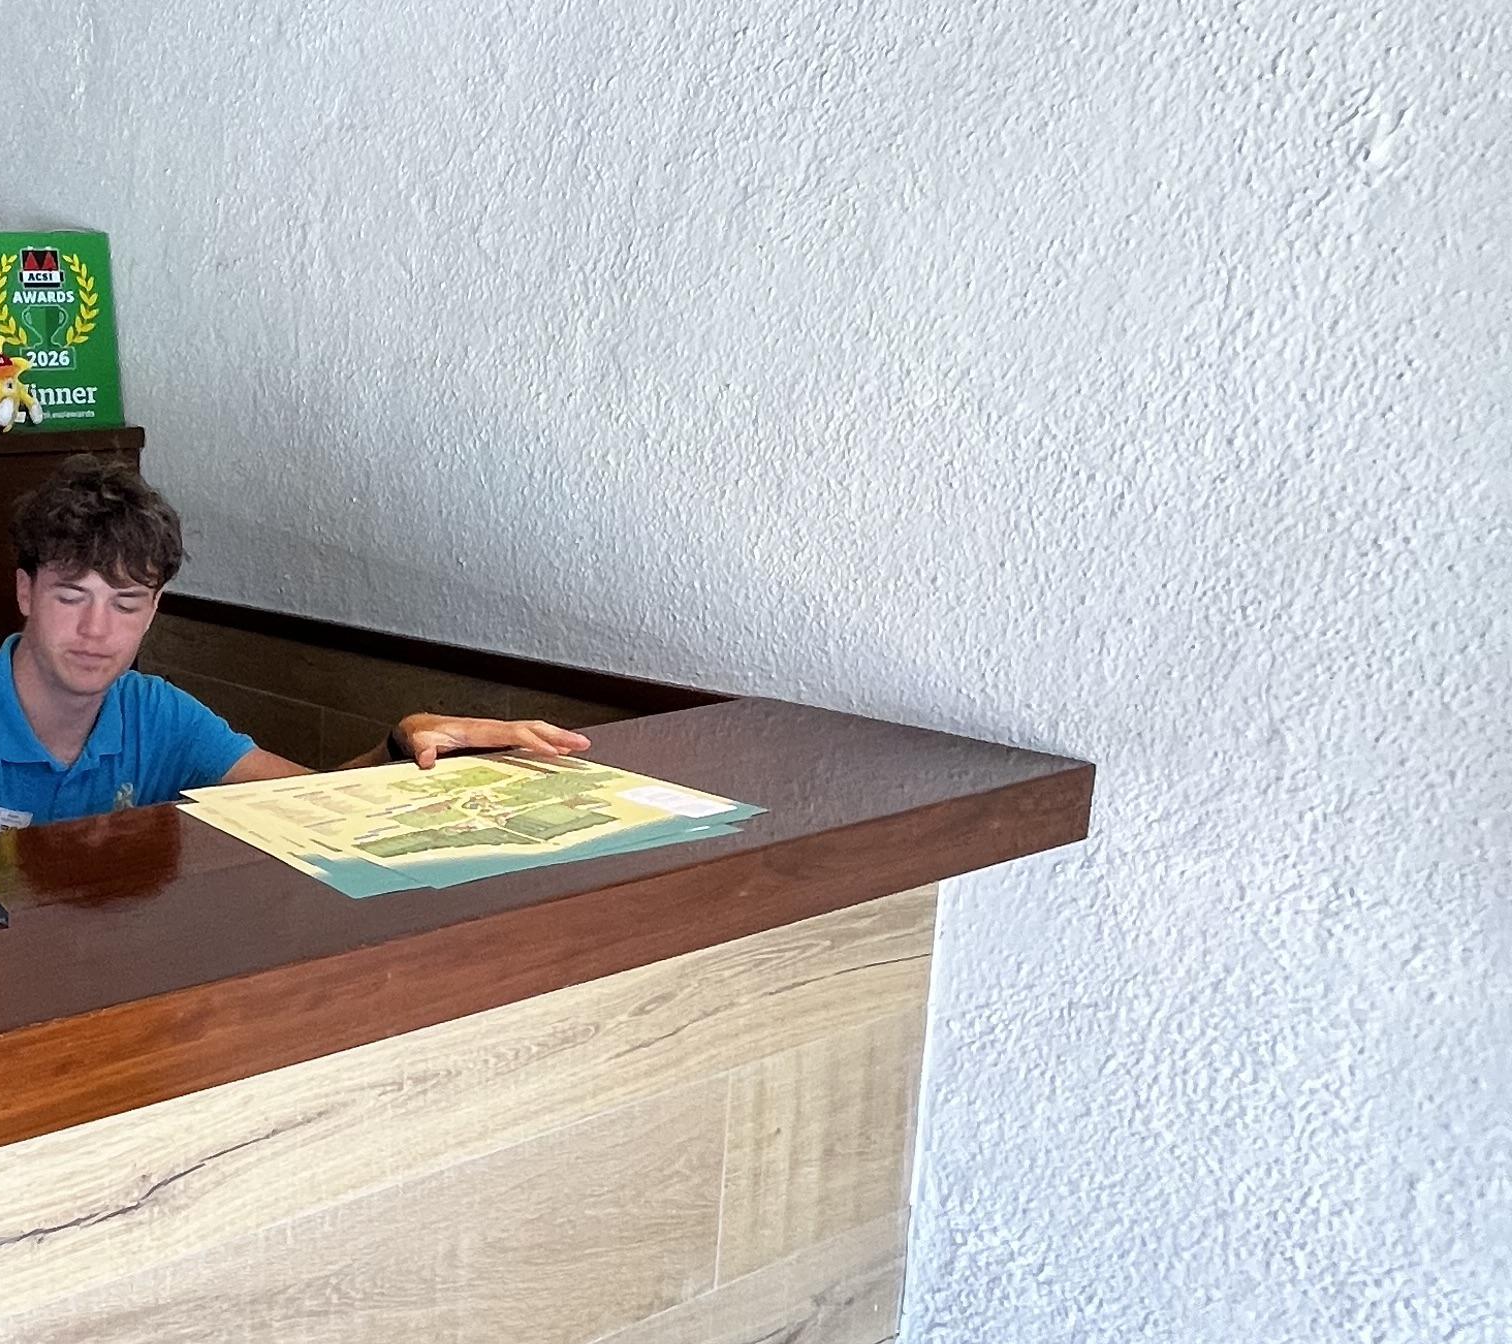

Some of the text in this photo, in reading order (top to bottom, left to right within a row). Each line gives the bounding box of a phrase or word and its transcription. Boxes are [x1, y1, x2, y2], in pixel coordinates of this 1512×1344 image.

[27, 270, 54, 282] ACSI
[12, 290, 75, 304] AWARDS
[26, 350, 70, 367] 2026
